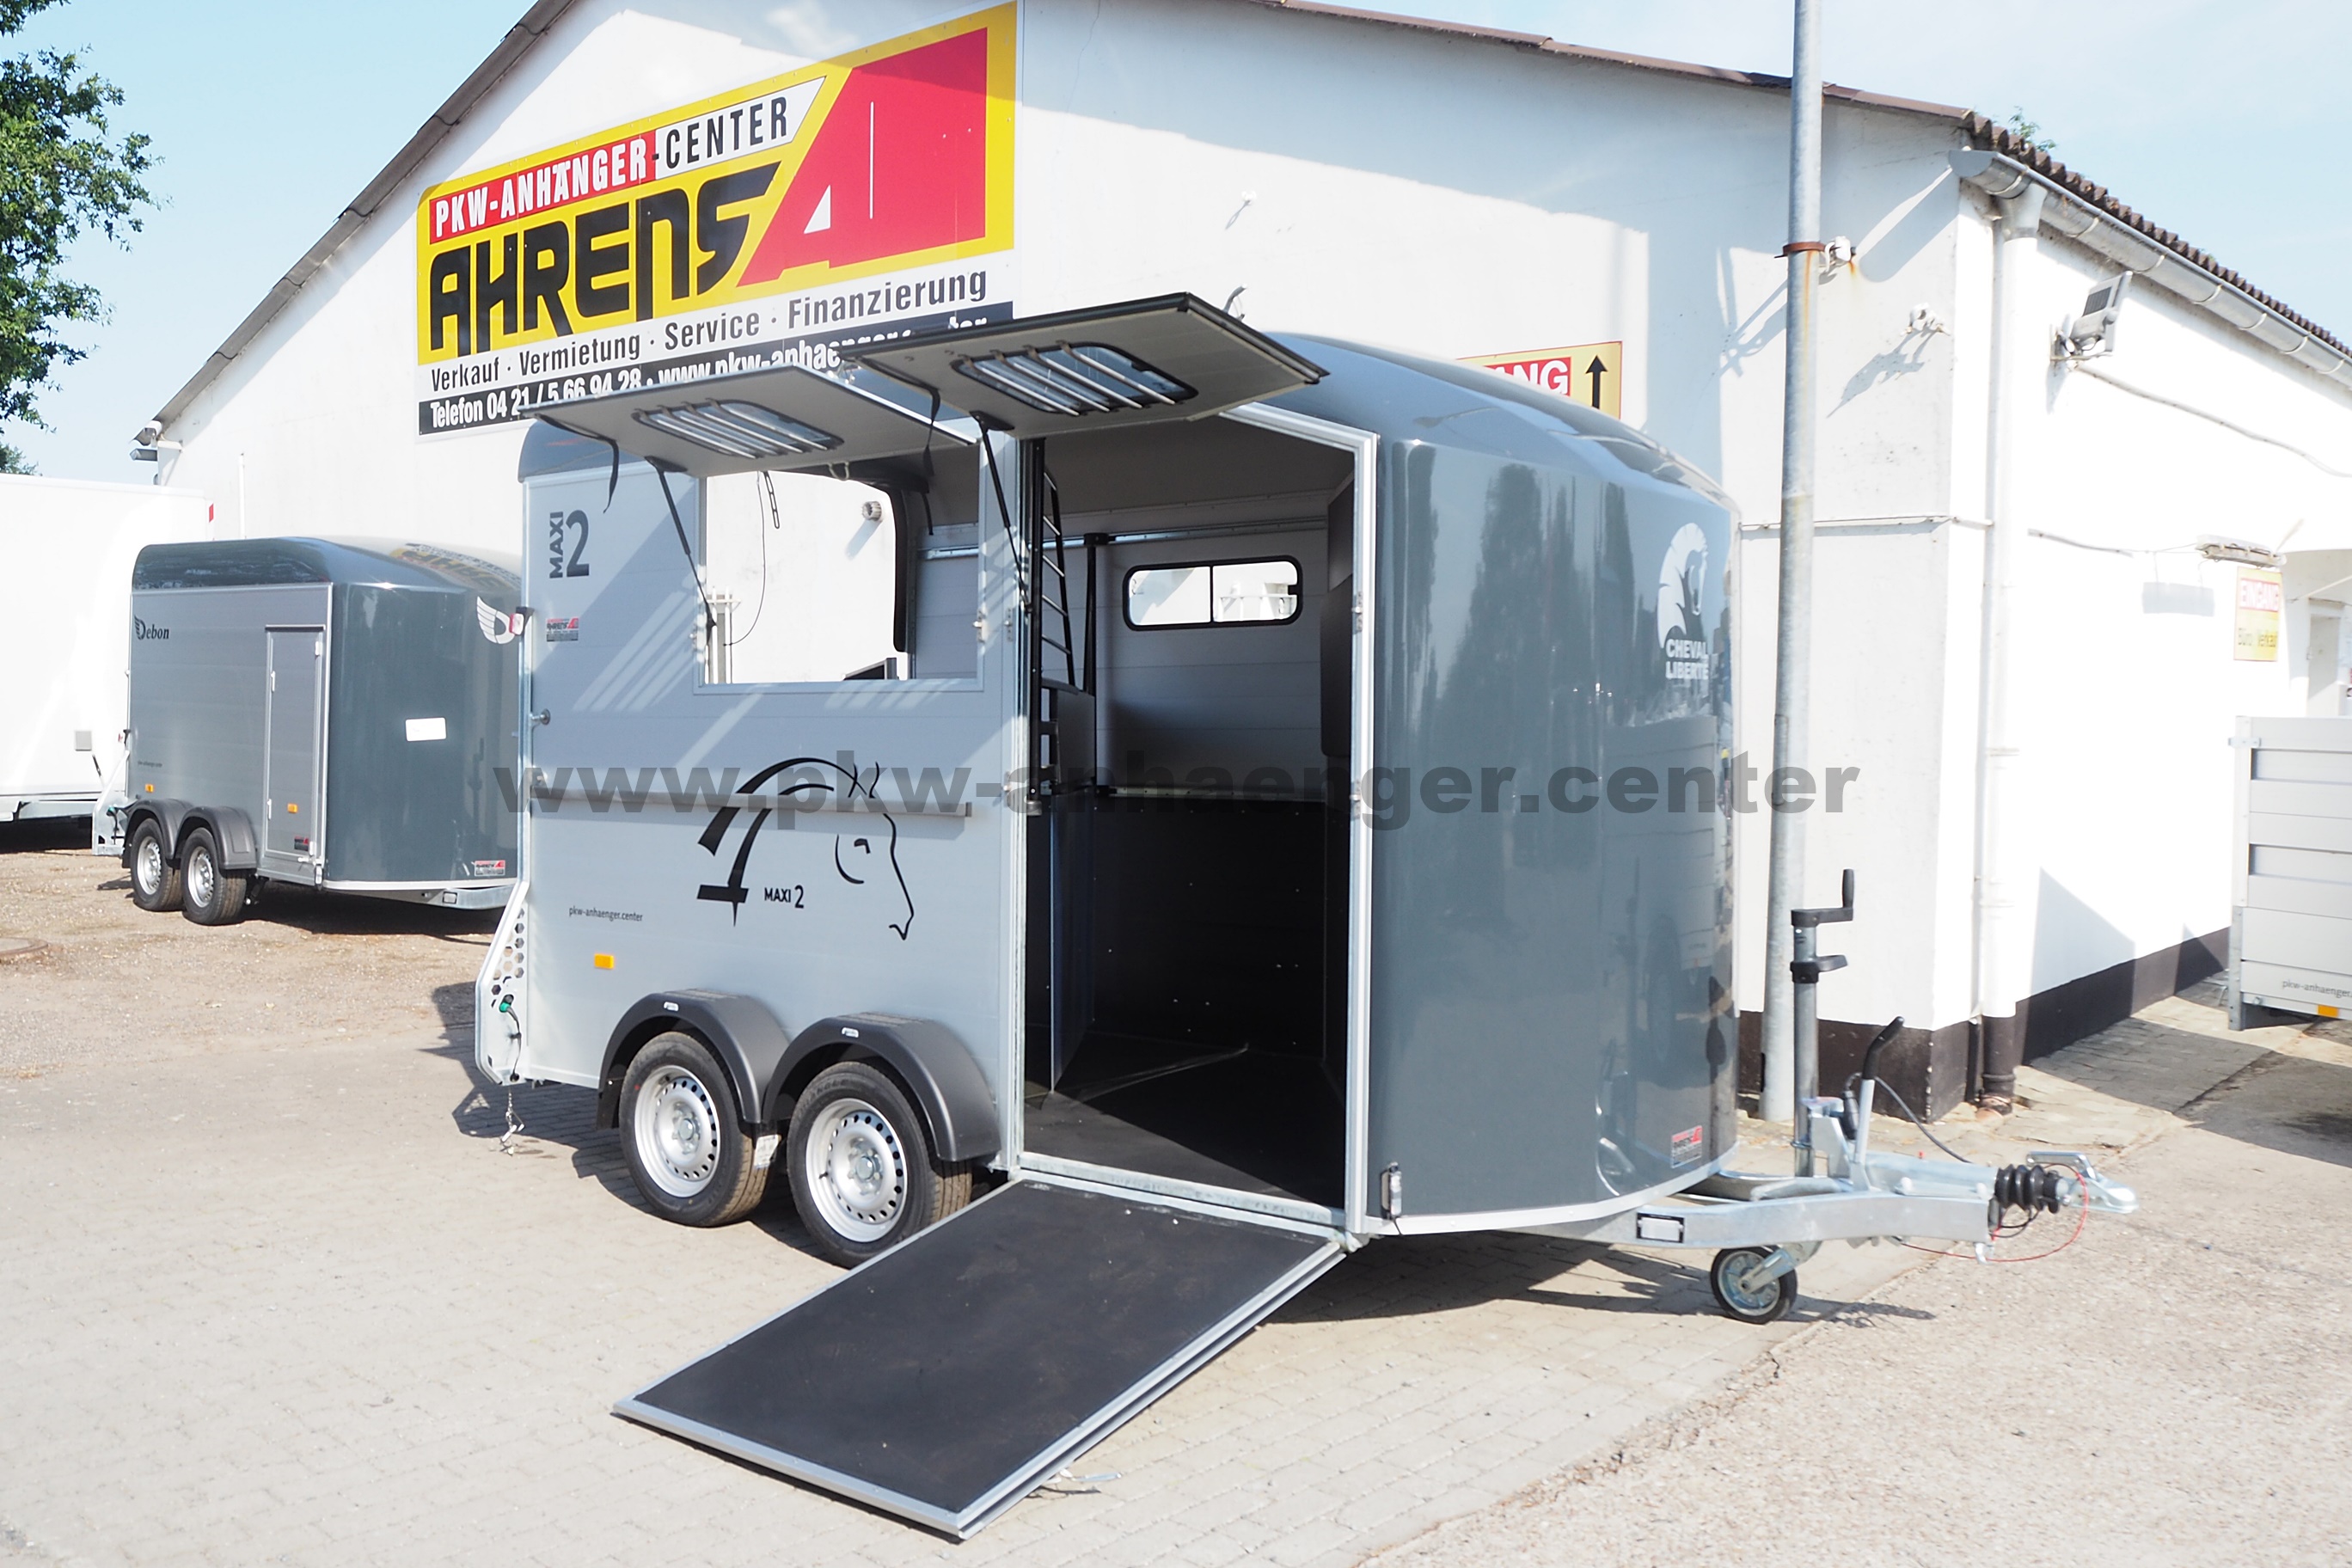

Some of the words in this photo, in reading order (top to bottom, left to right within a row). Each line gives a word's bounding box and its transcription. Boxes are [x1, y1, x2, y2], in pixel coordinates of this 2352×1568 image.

[430, 161, 782, 358] AHRENS
[431, 357, 499, 392] Verkauf
[519, 334, 640, 377] Vermietung
[665, 312, 760, 351] Service
[788, 270, 988, 329] Finanzierung
[430, 397, 483, 429] Telefon
[487, 390, 508, 420] 04
[511, 386, 530, 415] 21
[590, 372, 614, 398] 94
[617, 368, 642, 392] 28
[549, 511, 564, 579] MAXI
[566, 509, 590, 578] 2
[134, 615, 169, 640] Debon
[1665, 639, 1709, 659] CHEVAL
[568, 905, 643, 922] pkw-anhaenger.center
[764, 887, 791, 903] MAXI
[794, 885, 805, 909] 2
